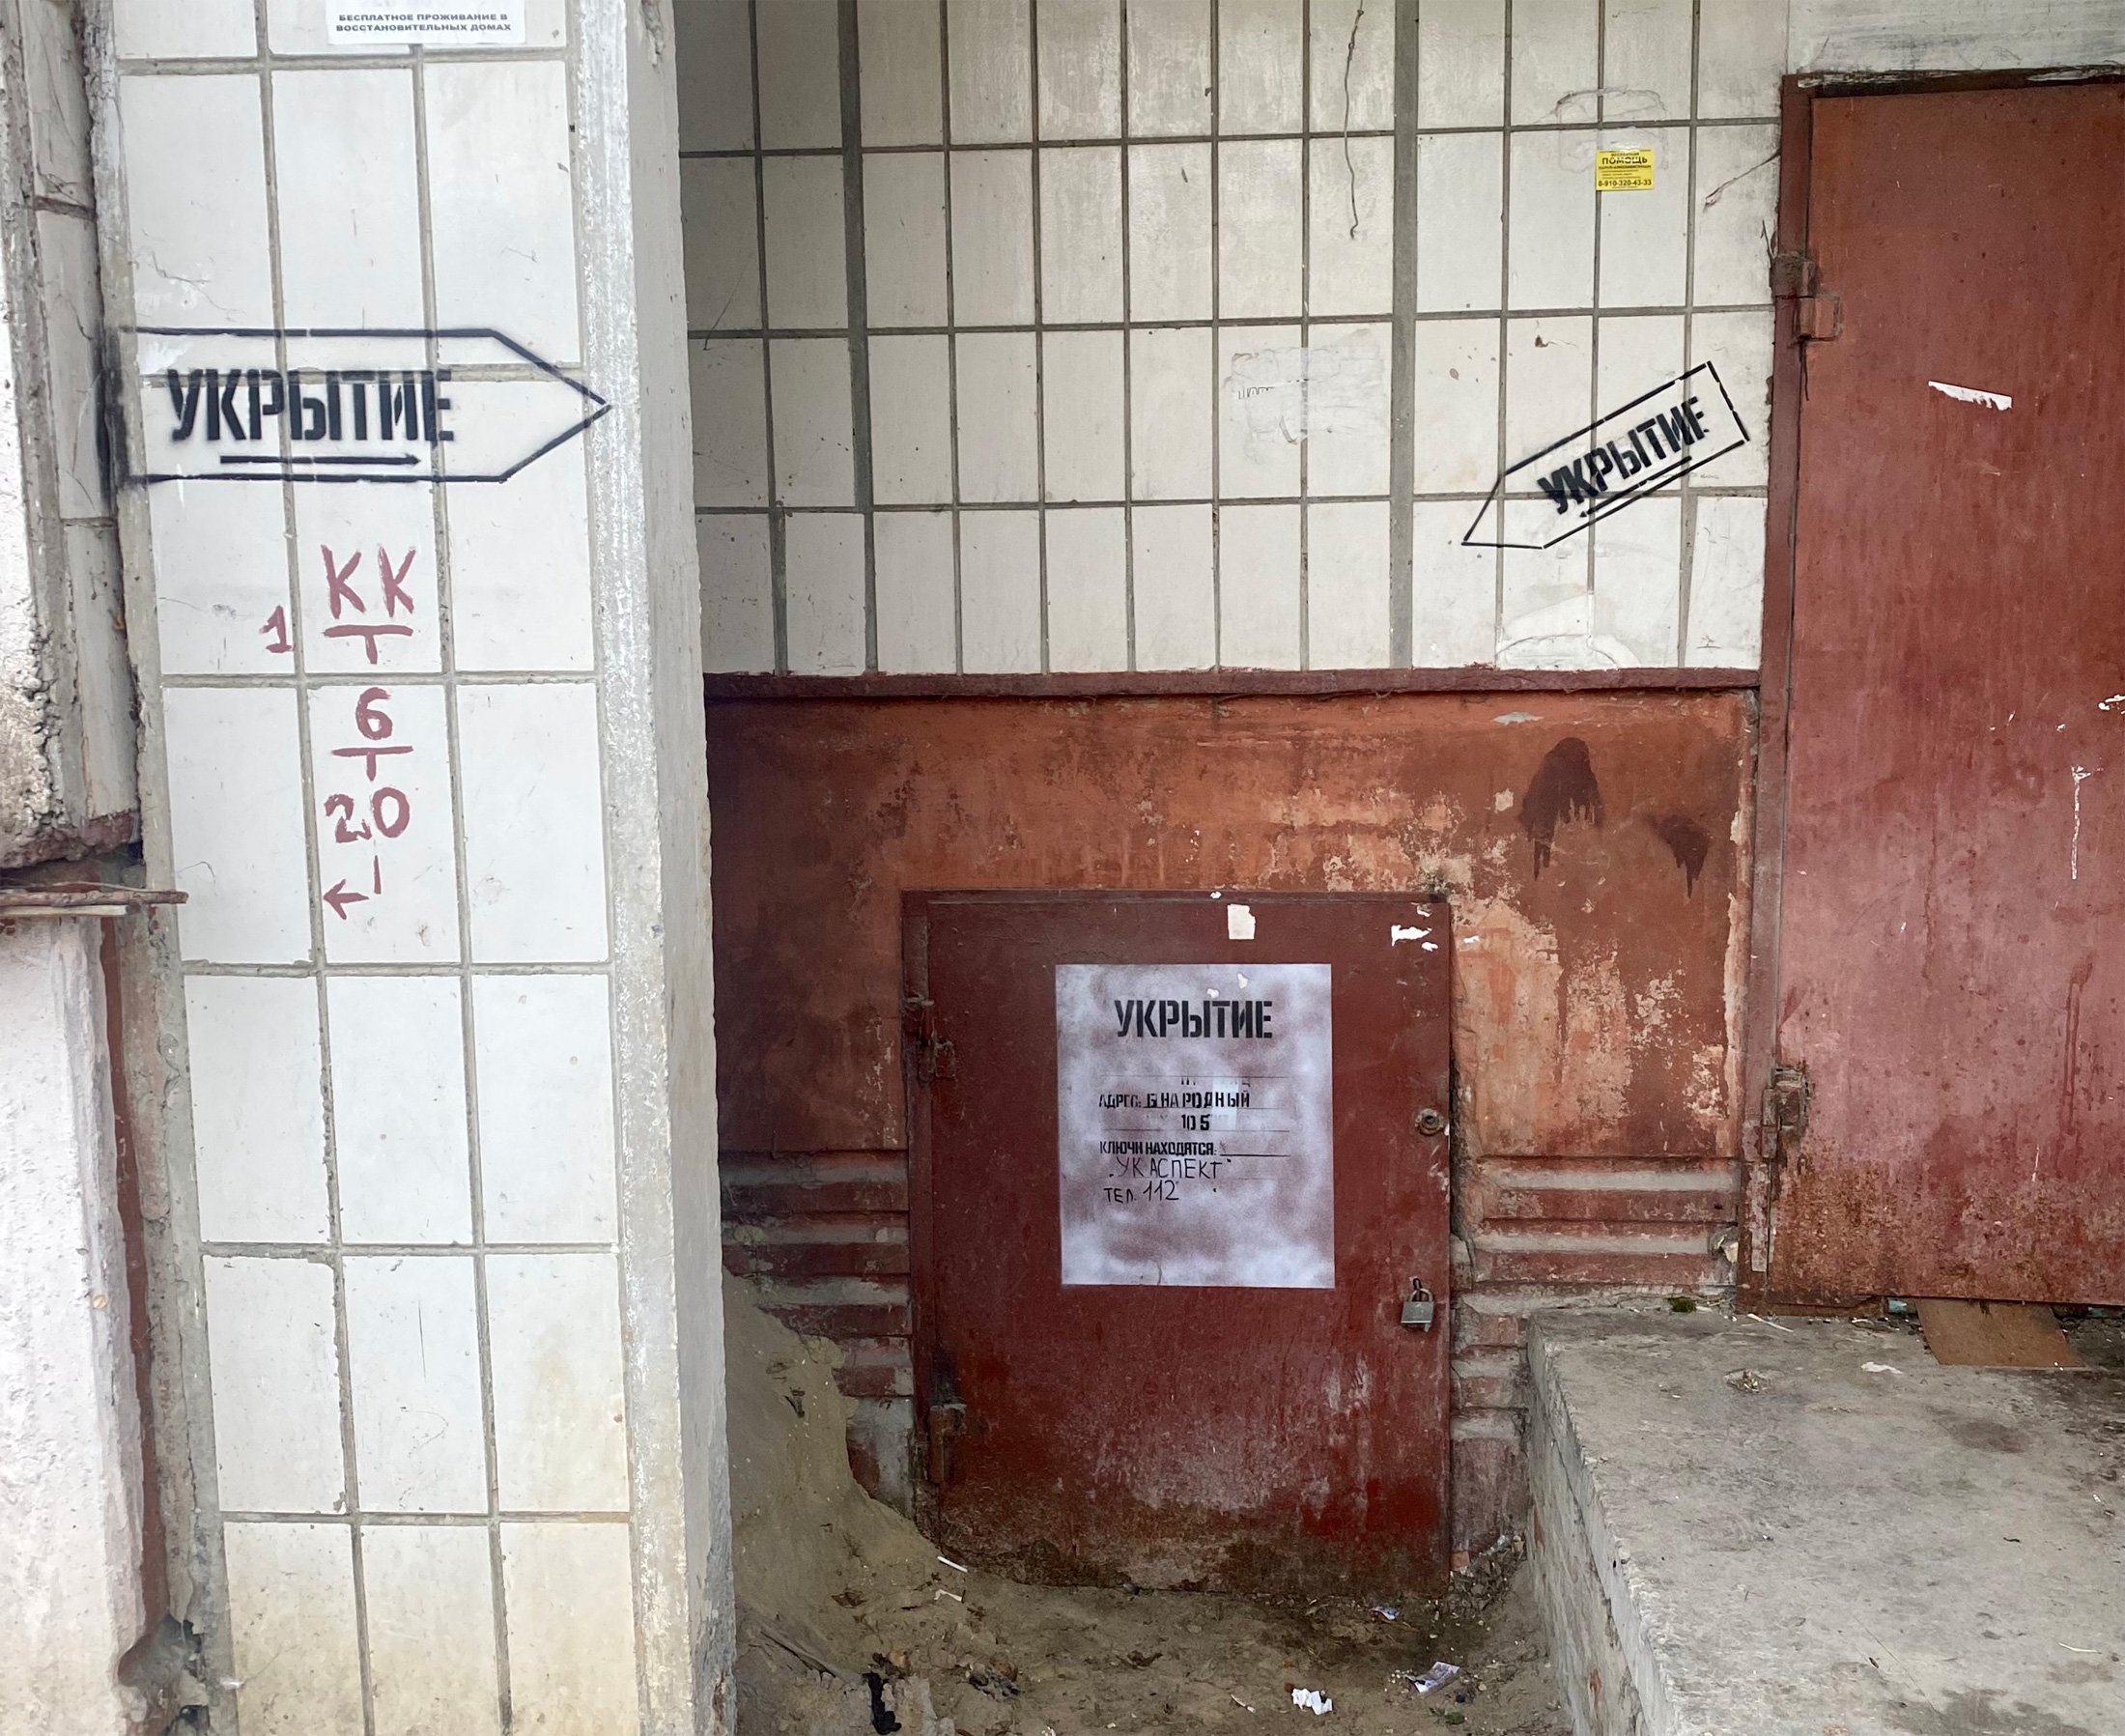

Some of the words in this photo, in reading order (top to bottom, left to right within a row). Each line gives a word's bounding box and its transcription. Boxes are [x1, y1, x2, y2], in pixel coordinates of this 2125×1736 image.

[167, 368, 455, 441] УКРЫТИЕ
[1537, 396, 1710, 515] УКРЫТИЕ
[260, 605, 293, 653] 1
[355, 687, 393, 741] 6
[325, 786, 411, 844] 20
[1115, 1000, 1273, 1039] УКРЫТИЕ
[1143, 1180, 1179, 1202] 112
